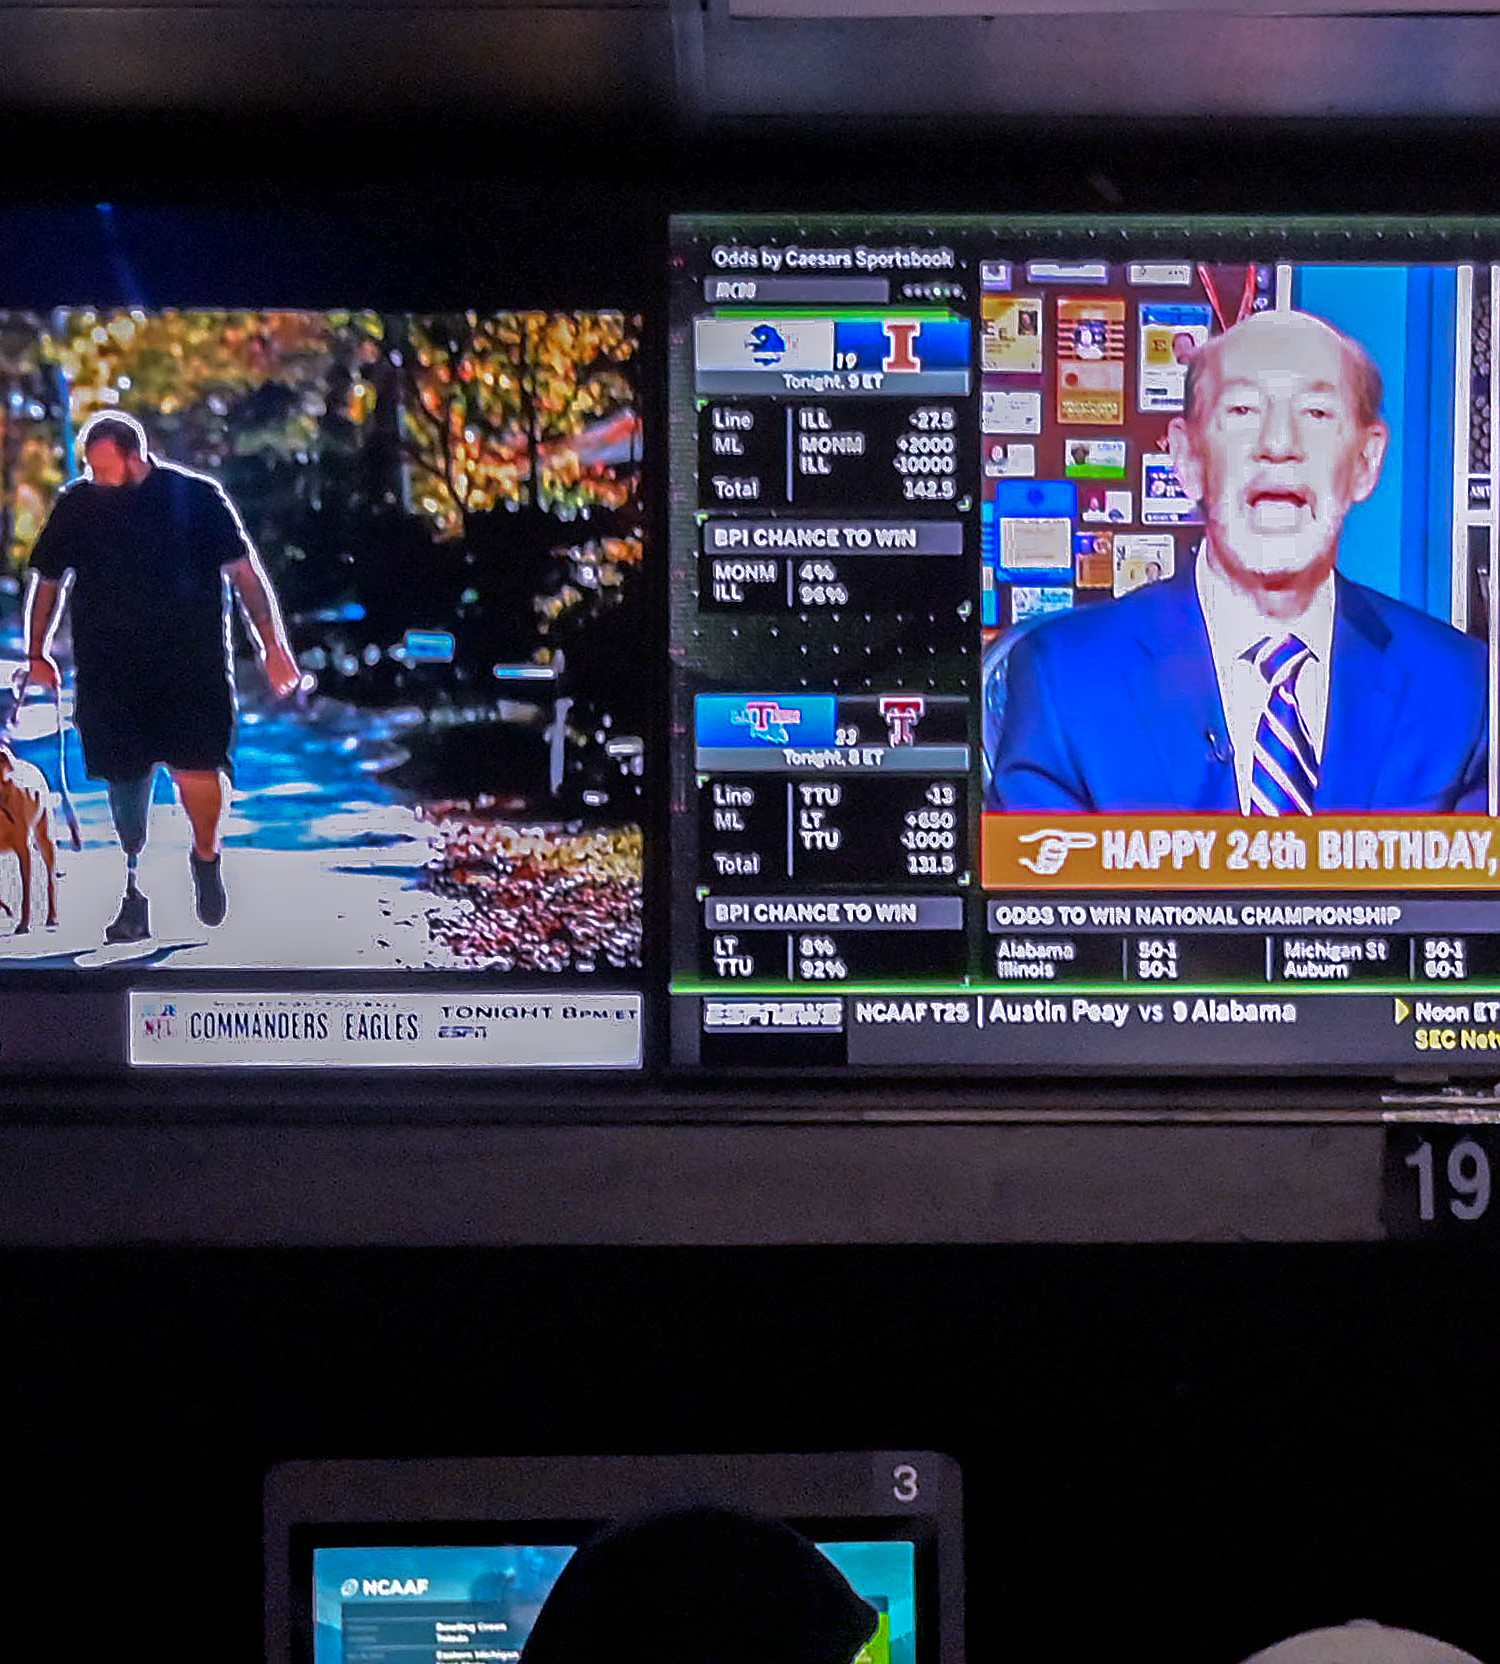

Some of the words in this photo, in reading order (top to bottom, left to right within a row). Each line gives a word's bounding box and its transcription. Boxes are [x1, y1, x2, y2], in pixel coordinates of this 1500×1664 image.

[713, 251, 758, 268] Odds
[762, 251, 782, 271] by
[785, 251, 852, 269] Caesars
[855, 251, 953, 271] Sportsbook
[836, 353, 857, 369] 19
[714, 436, 743, 453] ML
[801, 436, 864, 453] MONM
[714, 480, 759, 498] Total
[904, 480, 954, 498] 142.5
[714, 529, 749, 547] BPI
[753, 528, 840, 546] CHANCE
[844, 528, 871, 546] TO
[876, 528, 917, 546] WIN
[714, 565, 776, 581] MONM
[801, 564, 834, 581] 4%
[714, 788, 754, 806] Line
[801, 787, 841, 806] TTU
[714, 813, 744, 831] ML
[800, 813, 824, 831] LT
[801, 832, 841, 849] TTU
[1101, 830, 1216, 871] HAPPY
[1226, 830, 1307, 871] 24th
[1318, 830, 1499, 876] BIRTHDAY,
[715, 855, 760, 874] Total
[714, 904, 751, 922] BPI
[754, 904, 840, 923] CHANCE
[845, 904, 874, 923] TO
[875, 904, 917, 923] WIN
[995, 906, 1055, 926] ODDS
[1057, 906, 1087, 926] TO
[1090, 906, 1131, 926] WIN
[1134, 905, 1238, 925] NATIONAL
[1241, 905, 1402, 926] CHAMPIONSHIP
[714, 958, 753, 975] TTU
[990, 1001, 1067, 1024] Austin
[1071, 1001, 1129, 1029] Peay
[1138, 1005, 1164, 1024] vs
[1192, 1001, 1297, 1024] Alabama
[1416, 1002, 1469, 1024] Noon
[1473, 1002, 1499, 1024] ET
[189, 1012, 329, 1041] COMMANDERS
[344, 1012, 420, 1041] EAGLES
[1415, 1029, 1456, 1051] SEC
[1404, 1140, 1492, 1222] 19
[893, 1464, 919, 1501] 3
[362, 1578, 430, 1596] NCAAF
